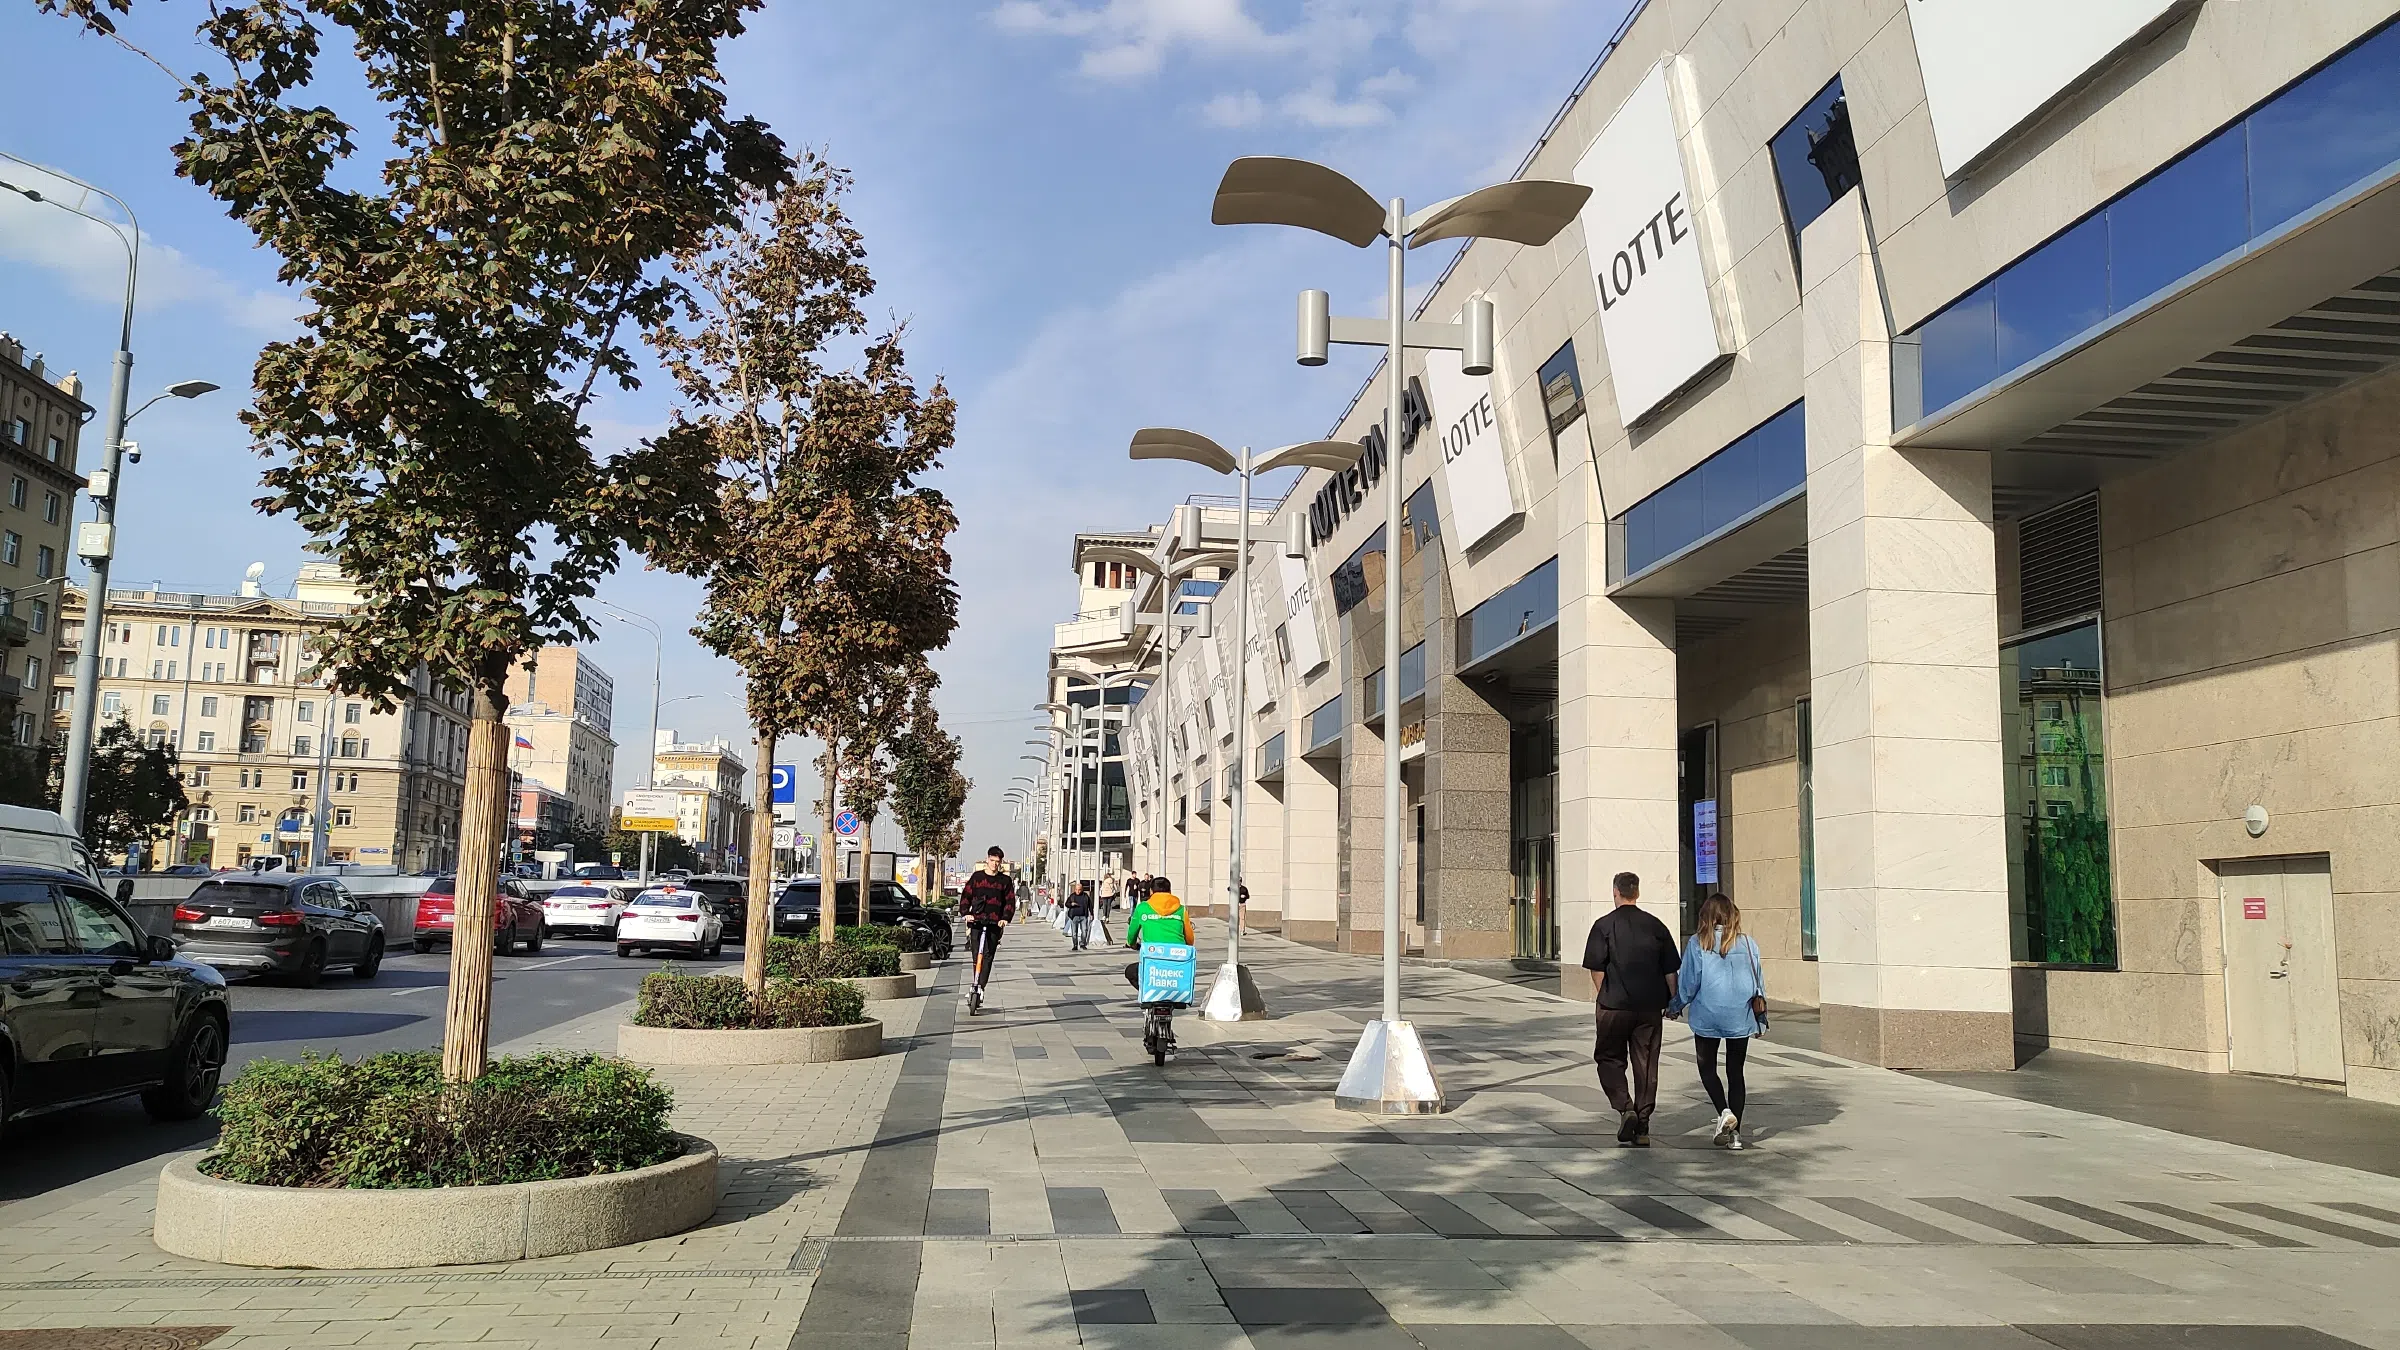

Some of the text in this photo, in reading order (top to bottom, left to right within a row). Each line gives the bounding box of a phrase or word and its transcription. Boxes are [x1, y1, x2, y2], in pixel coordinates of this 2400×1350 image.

[1597, 190, 1688, 311] LOTTE
[1442, 391, 1493, 465] LOTTE
[1287, 581, 1310, 620] LOTTE
[777, 833, 789, 841] 20
[1148, 976, 1178, 988] Лавка
[1149, 966, 1184, 978] Яндекс
